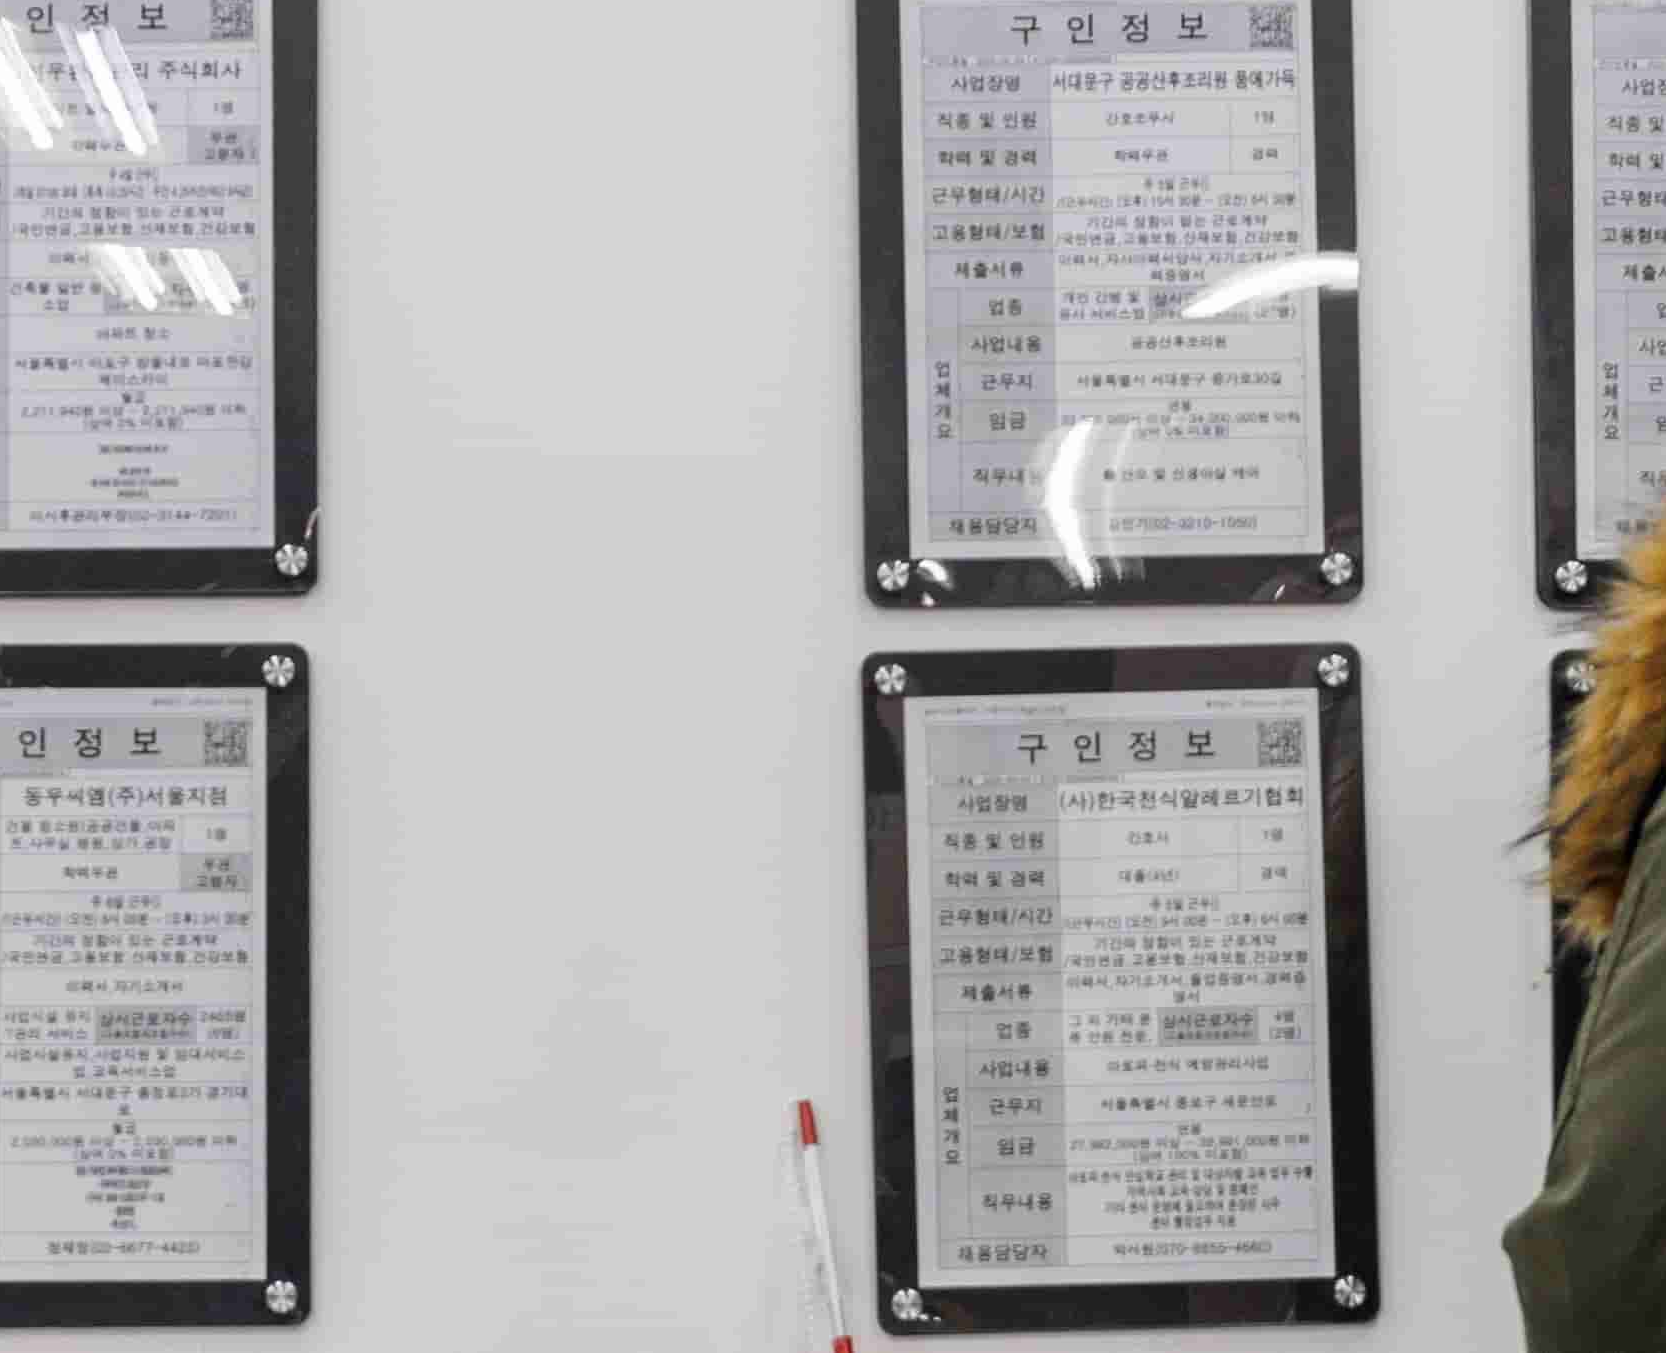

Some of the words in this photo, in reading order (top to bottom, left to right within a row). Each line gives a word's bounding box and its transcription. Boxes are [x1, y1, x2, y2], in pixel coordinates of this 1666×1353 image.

[157, 59, 242, 80] 주식회사
[950, 74, 1021, 93] 사업장명
[1052, 70, 1115, 92] 서대문구
[932, 182, 1046, 208] 근무형태/시간
[932, 222, 1046, 243] 고용형태/보험
[957, 794, 1028, 816] 사업장명
[1059, 786, 1304, 812] (사)한국천식알레르기협회
[938, 907, 1054, 927] 근무형태/시간
[939, 945, 1054, 966] 고용형태/보험
